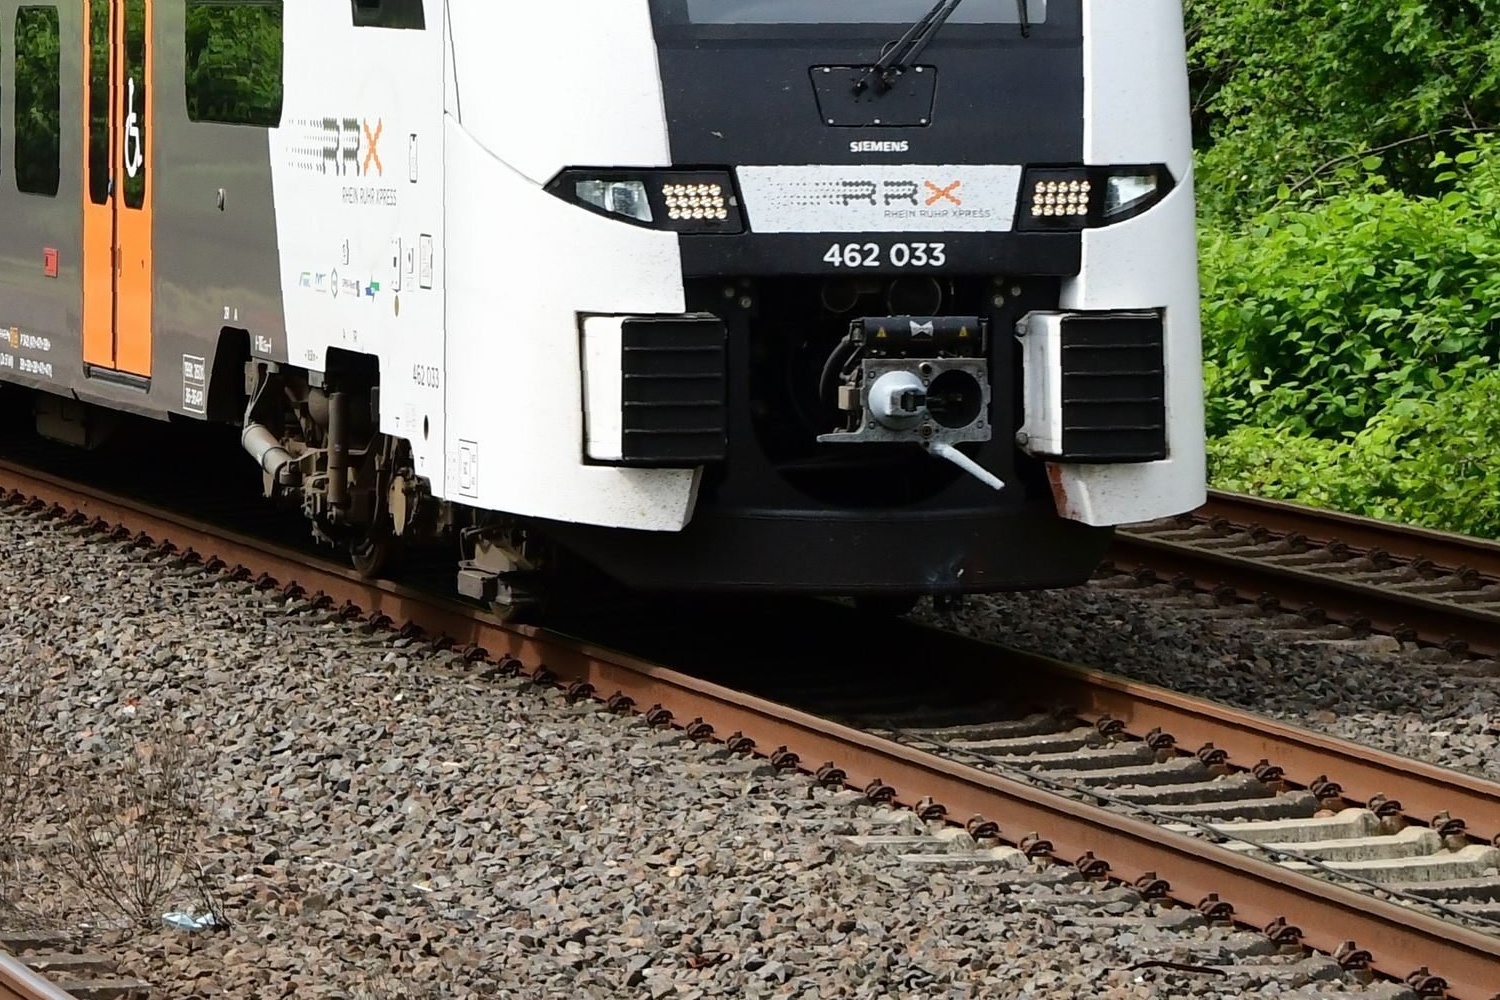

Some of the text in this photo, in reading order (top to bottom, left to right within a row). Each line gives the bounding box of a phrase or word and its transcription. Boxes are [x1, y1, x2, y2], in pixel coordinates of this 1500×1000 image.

[849, 140, 909, 153] SIEMENS
[841, 180, 963, 206] RRX
[884, 208, 991, 219] RHEIN RUHR XPRESS
[822, 242, 946, 268] 462 033
[413, 363, 440, 389] 462 033
